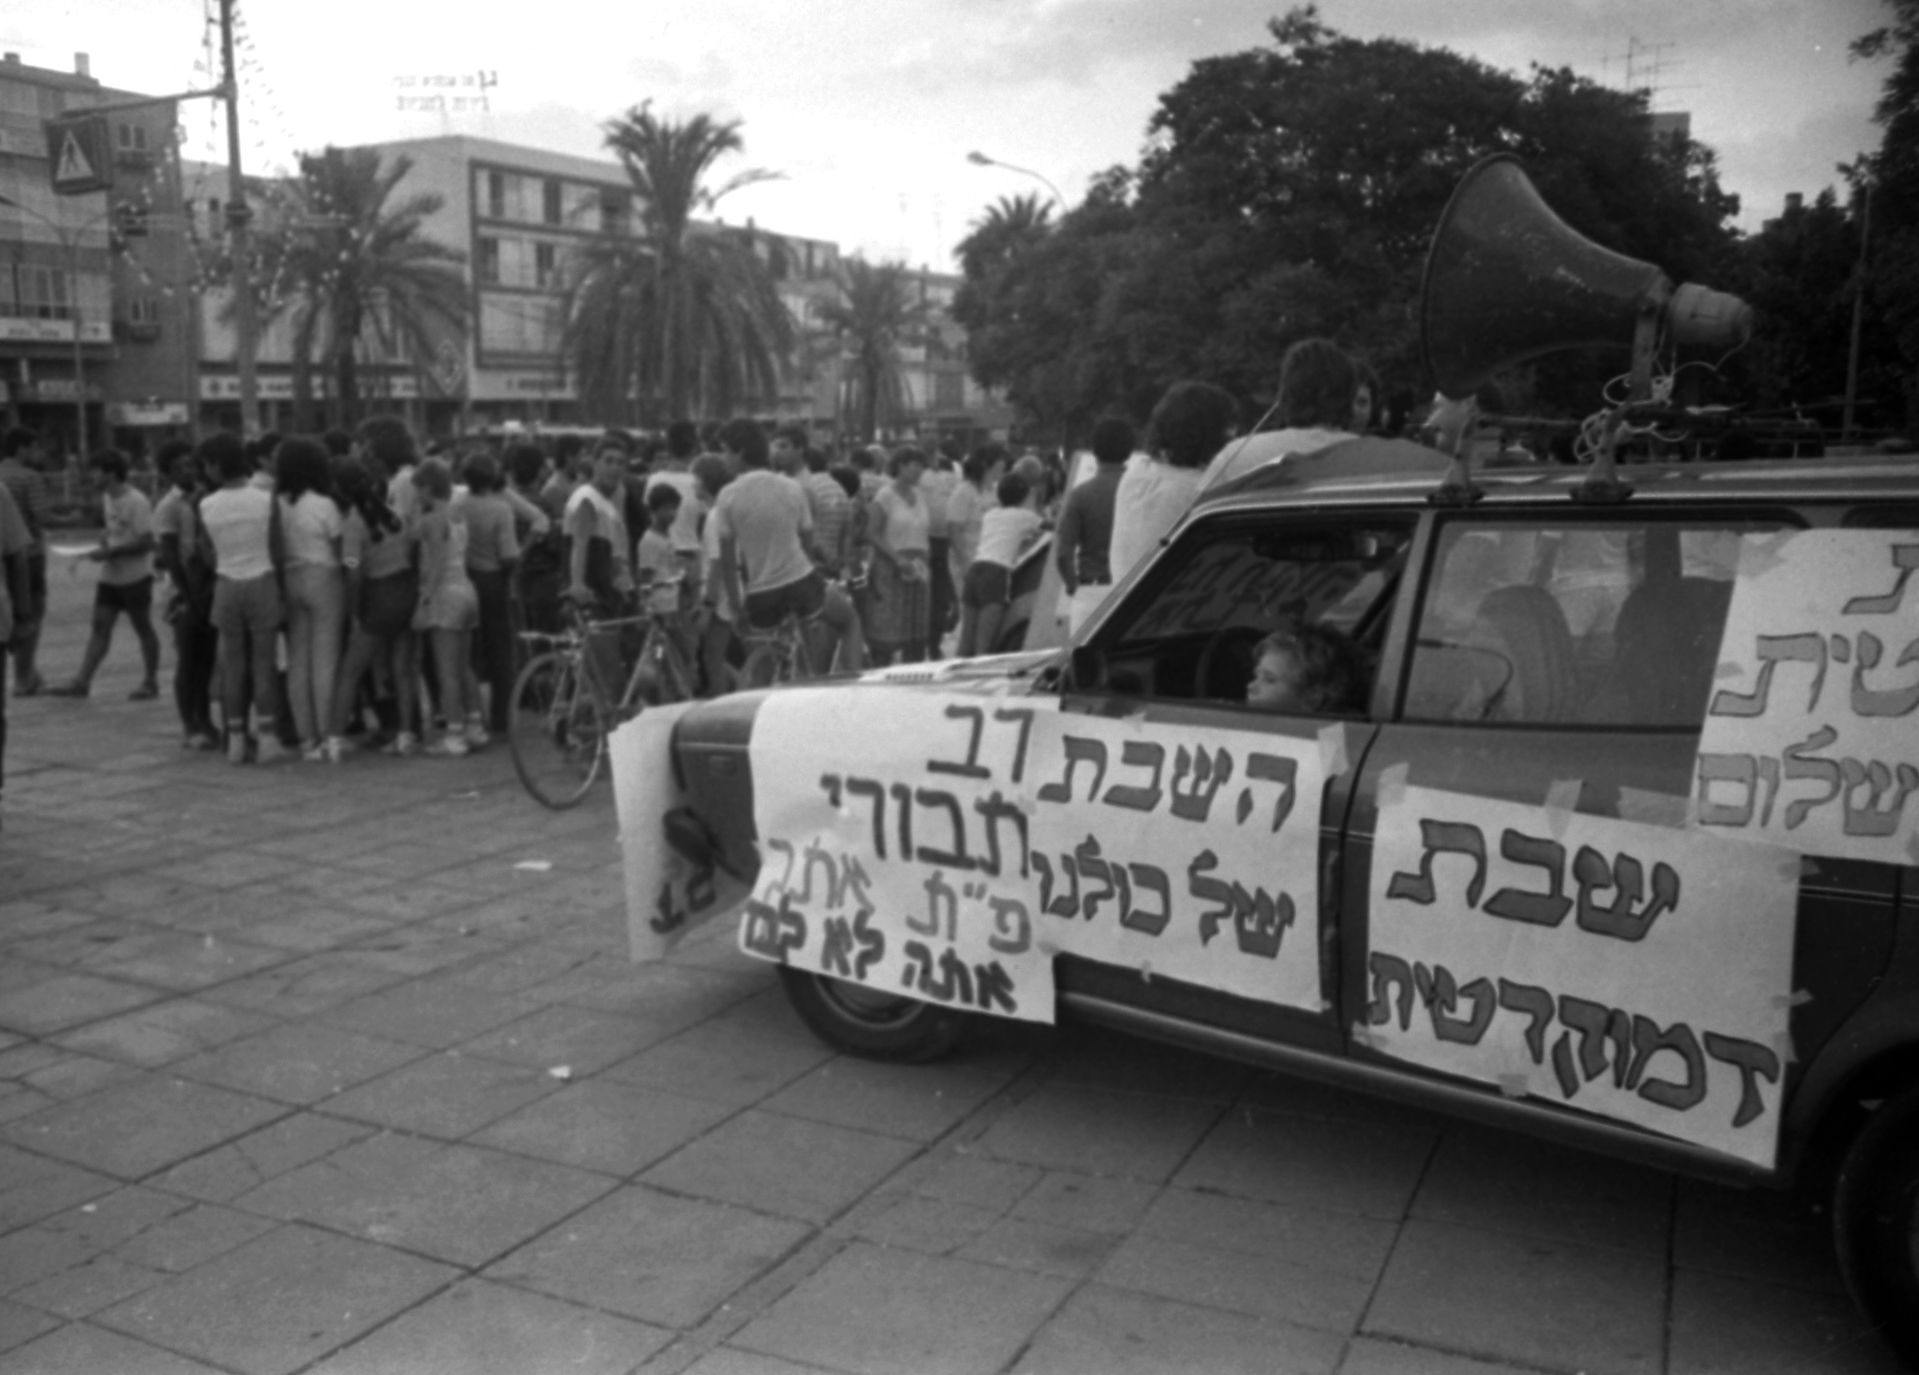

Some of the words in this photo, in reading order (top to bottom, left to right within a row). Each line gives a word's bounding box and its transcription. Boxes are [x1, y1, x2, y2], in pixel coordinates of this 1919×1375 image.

[820, 773, 1029, 880] תבורי
[1036, 734, 1298, 834] השבת
[1030, 833, 1172, 937] כולנו
[1188, 848, 1296, 960] של
[1386, 817, 1681, 942] שבת
[822, 907, 886, 981] לא
[901, 939, 1017, 1015] אתה
[1365, 950, 1780, 1129] דמוקרטית
